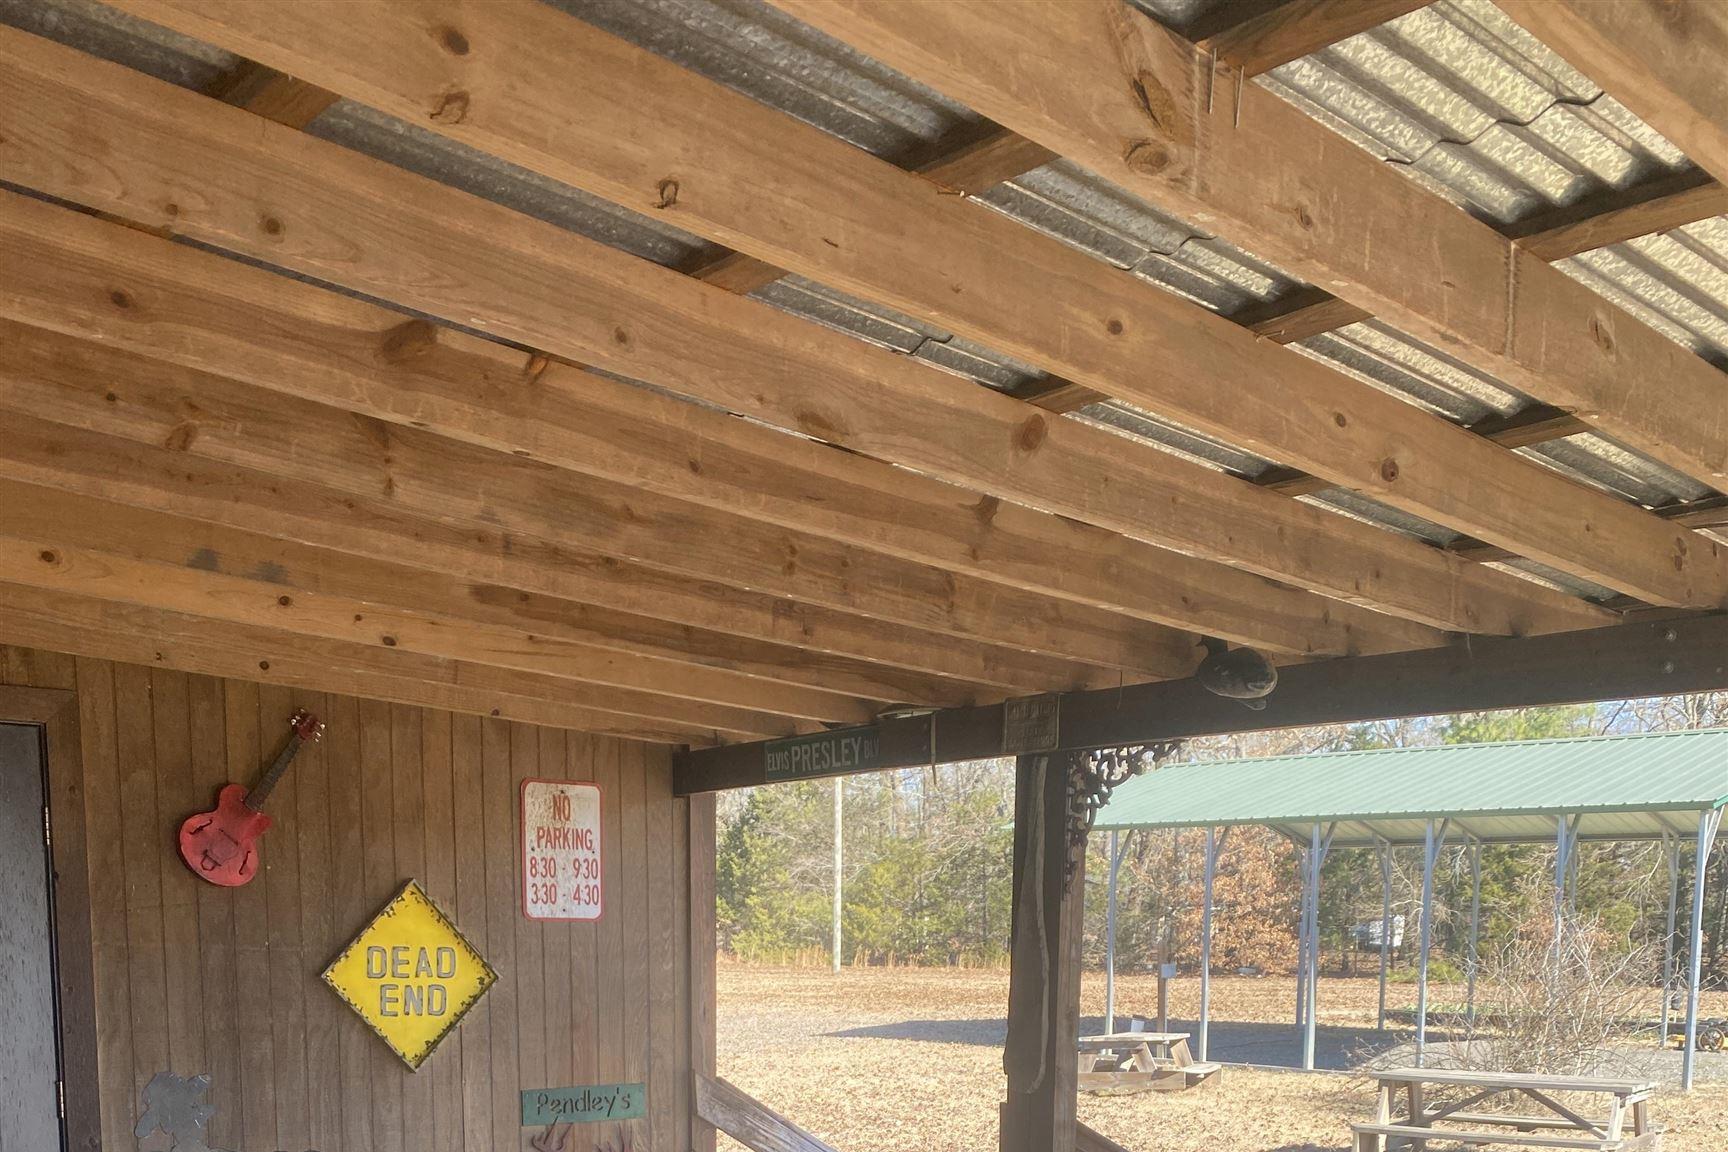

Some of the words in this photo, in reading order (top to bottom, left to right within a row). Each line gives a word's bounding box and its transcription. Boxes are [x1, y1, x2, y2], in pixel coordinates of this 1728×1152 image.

[767, 751, 790, 772] ELVIS
[791, 736, 862, 774] PRESLEY
[552, 793, 571, 822] NO
[536, 825, 593, 851] PARKING
[366, 945, 456, 980] DEAD
[379, 983, 447, 1017] END
[536, 1086, 632, 1118] Pendley's
